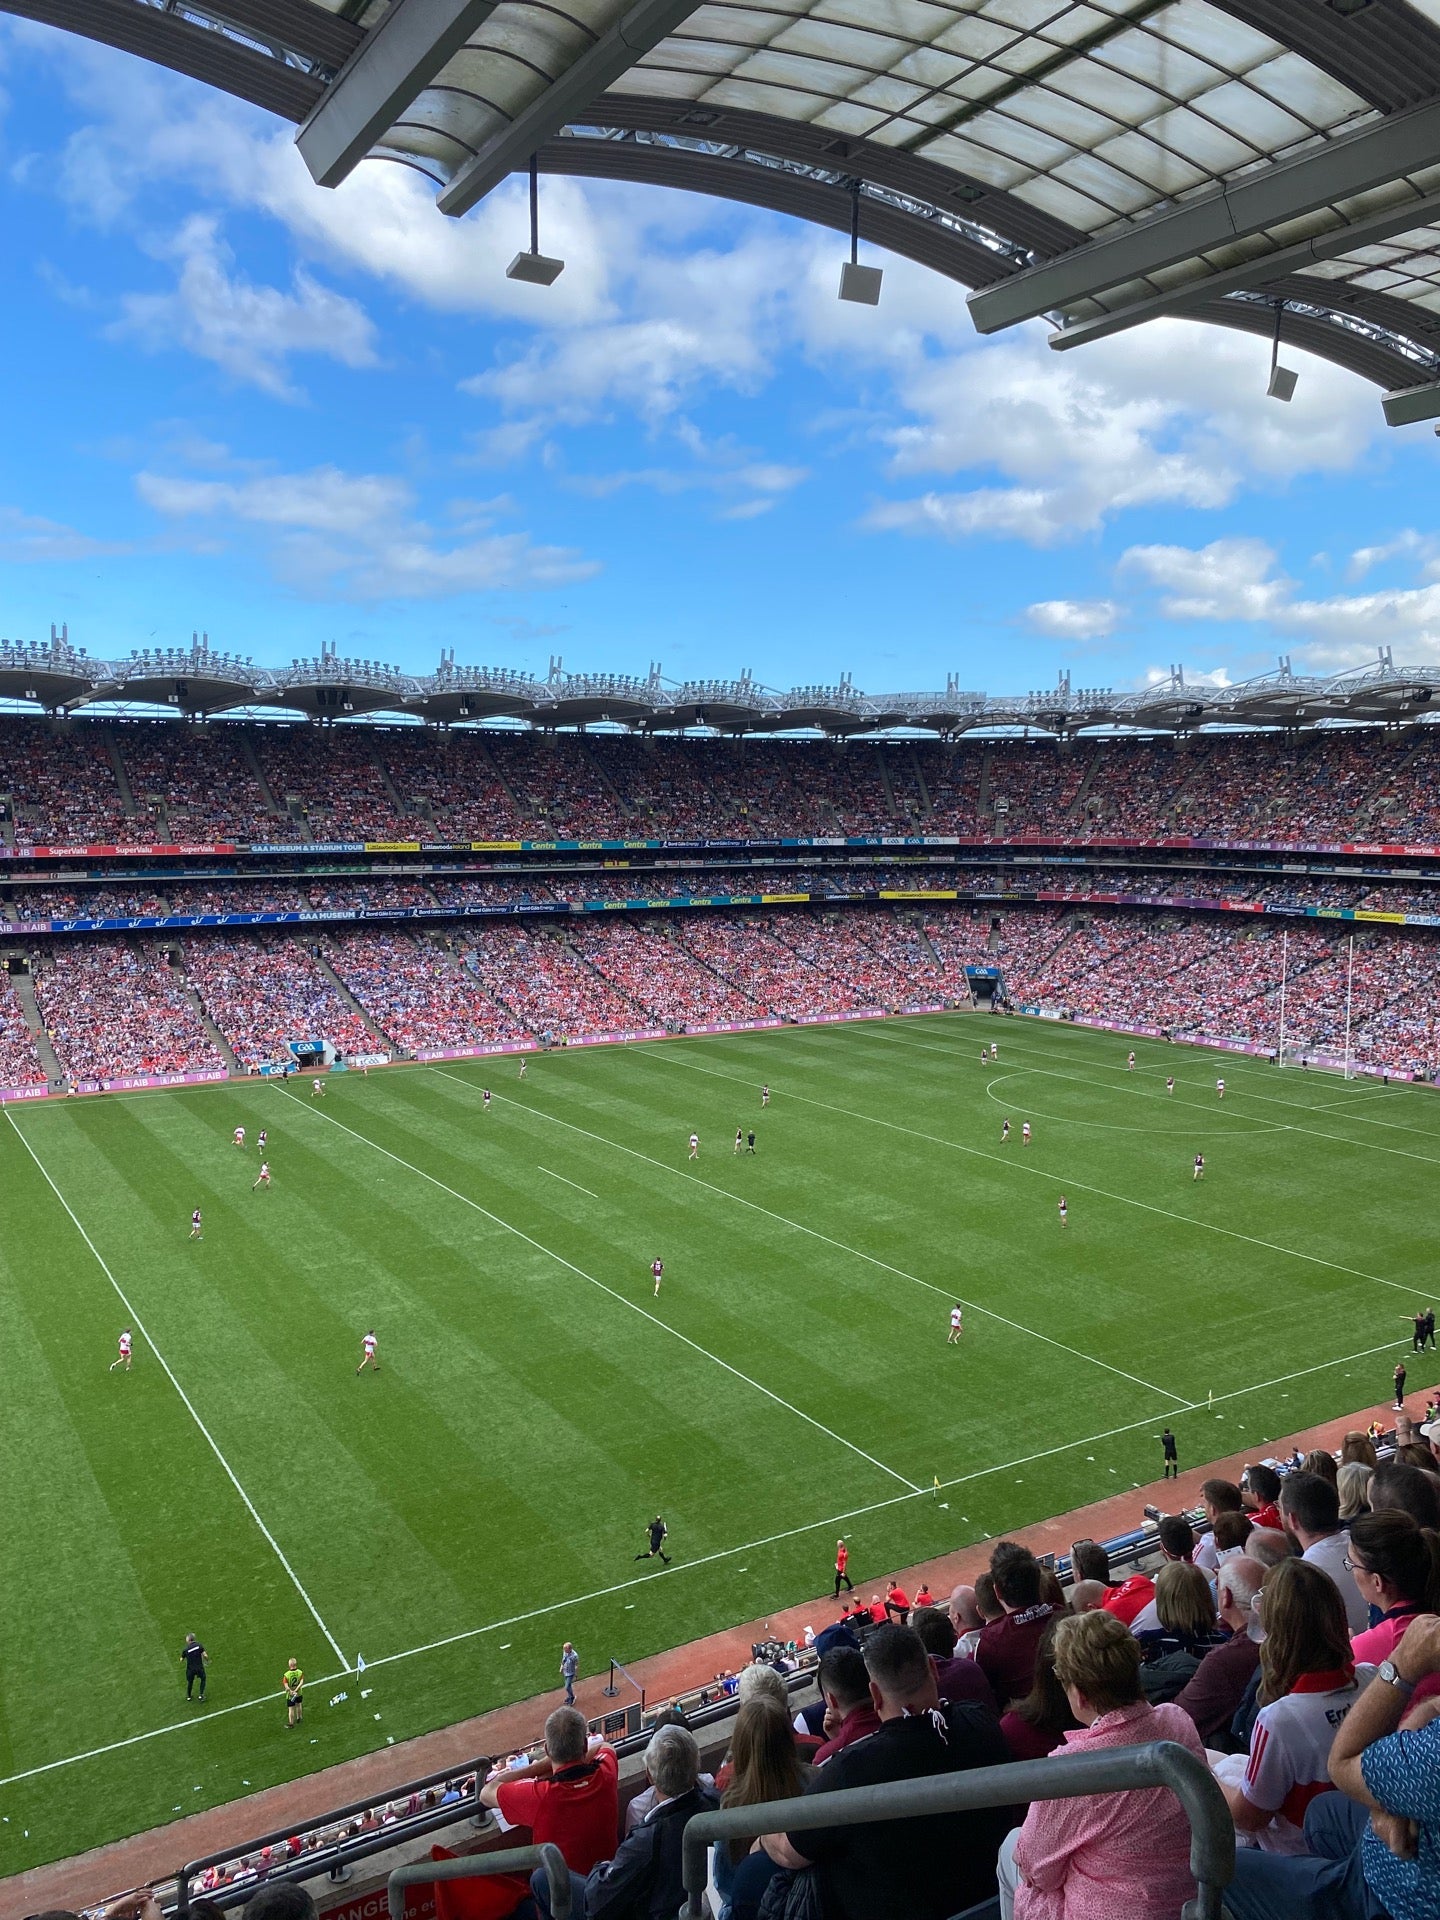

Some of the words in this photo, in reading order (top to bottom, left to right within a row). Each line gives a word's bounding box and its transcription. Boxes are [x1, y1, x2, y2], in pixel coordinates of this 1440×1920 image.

[49, 848, 87, 856] SuperValu
[115, 847, 152, 855] SuperValu
[180, 846, 215, 854] SuperValu
[1354, 845, 1383, 853] SuperValu
[1404, 846, 1435, 854] SuperValu
[647, 900, 670, 908] Centra
[300, 912, 318, 920] GAA
[319, 911, 355, 919] MUSEUM
[1317, 909, 1342, 918] Centra
[31, 923, 47, 931] AIB
[297, 1043, 315, 1052] GAA
[207, 1072, 221, 1080] AIB
[95, 1082, 110, 1091] AB
[133, 1079, 148, 1087] AIB
[24, 1089, 41, 1097] AIB
[292, 1677, 299, 1688] 2
